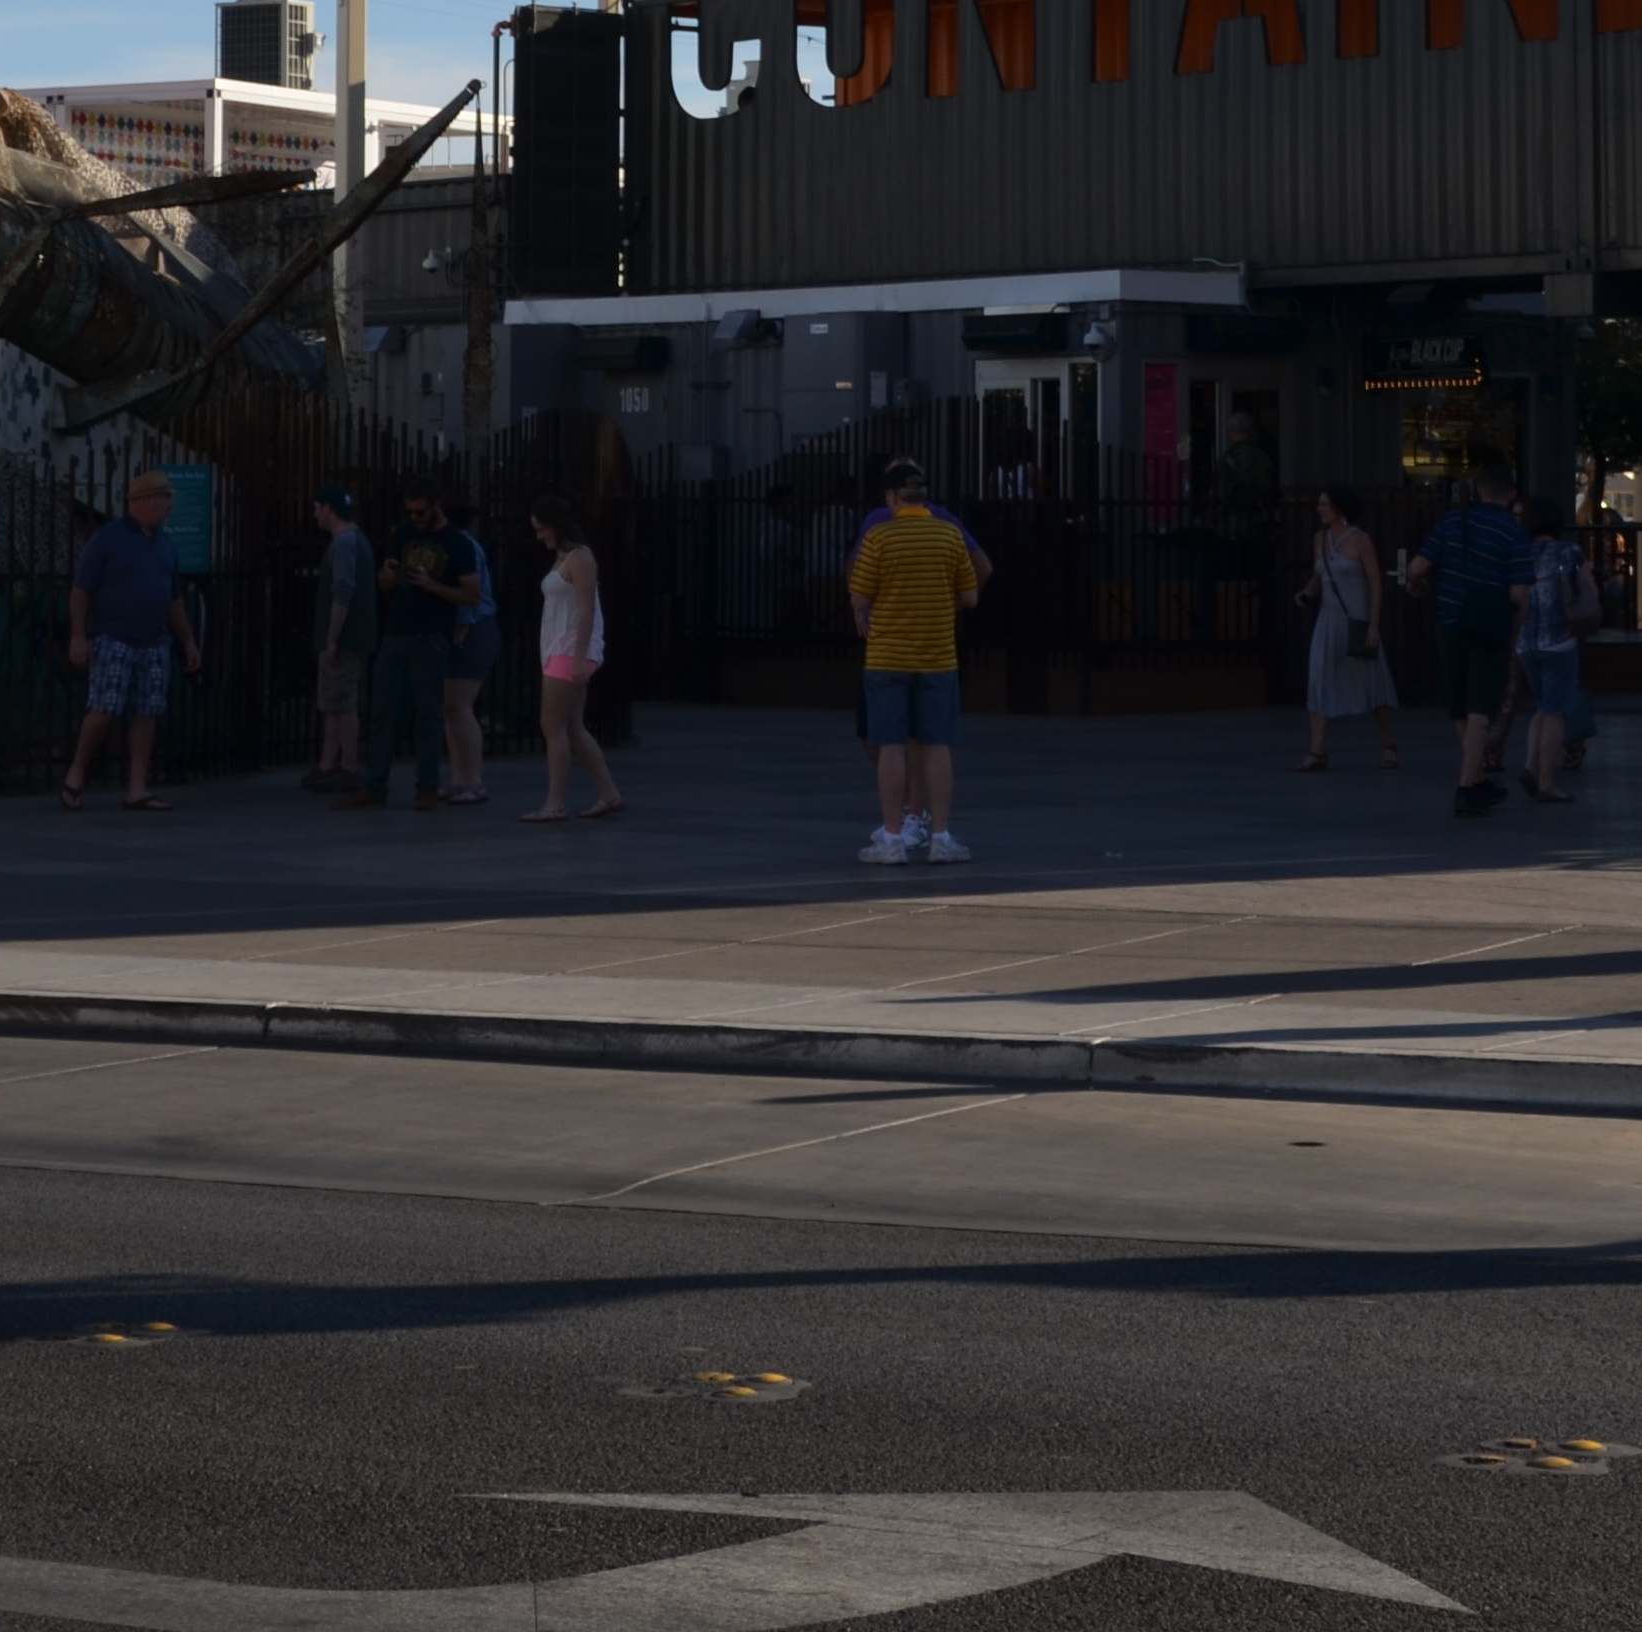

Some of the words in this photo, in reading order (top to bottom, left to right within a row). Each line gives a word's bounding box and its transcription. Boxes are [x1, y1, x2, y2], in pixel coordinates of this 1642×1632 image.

[1410, 338, 1443, 364] BLACK
[1443, 337, 1465, 363] CUP
[619, 386, 650, 413] 1050
